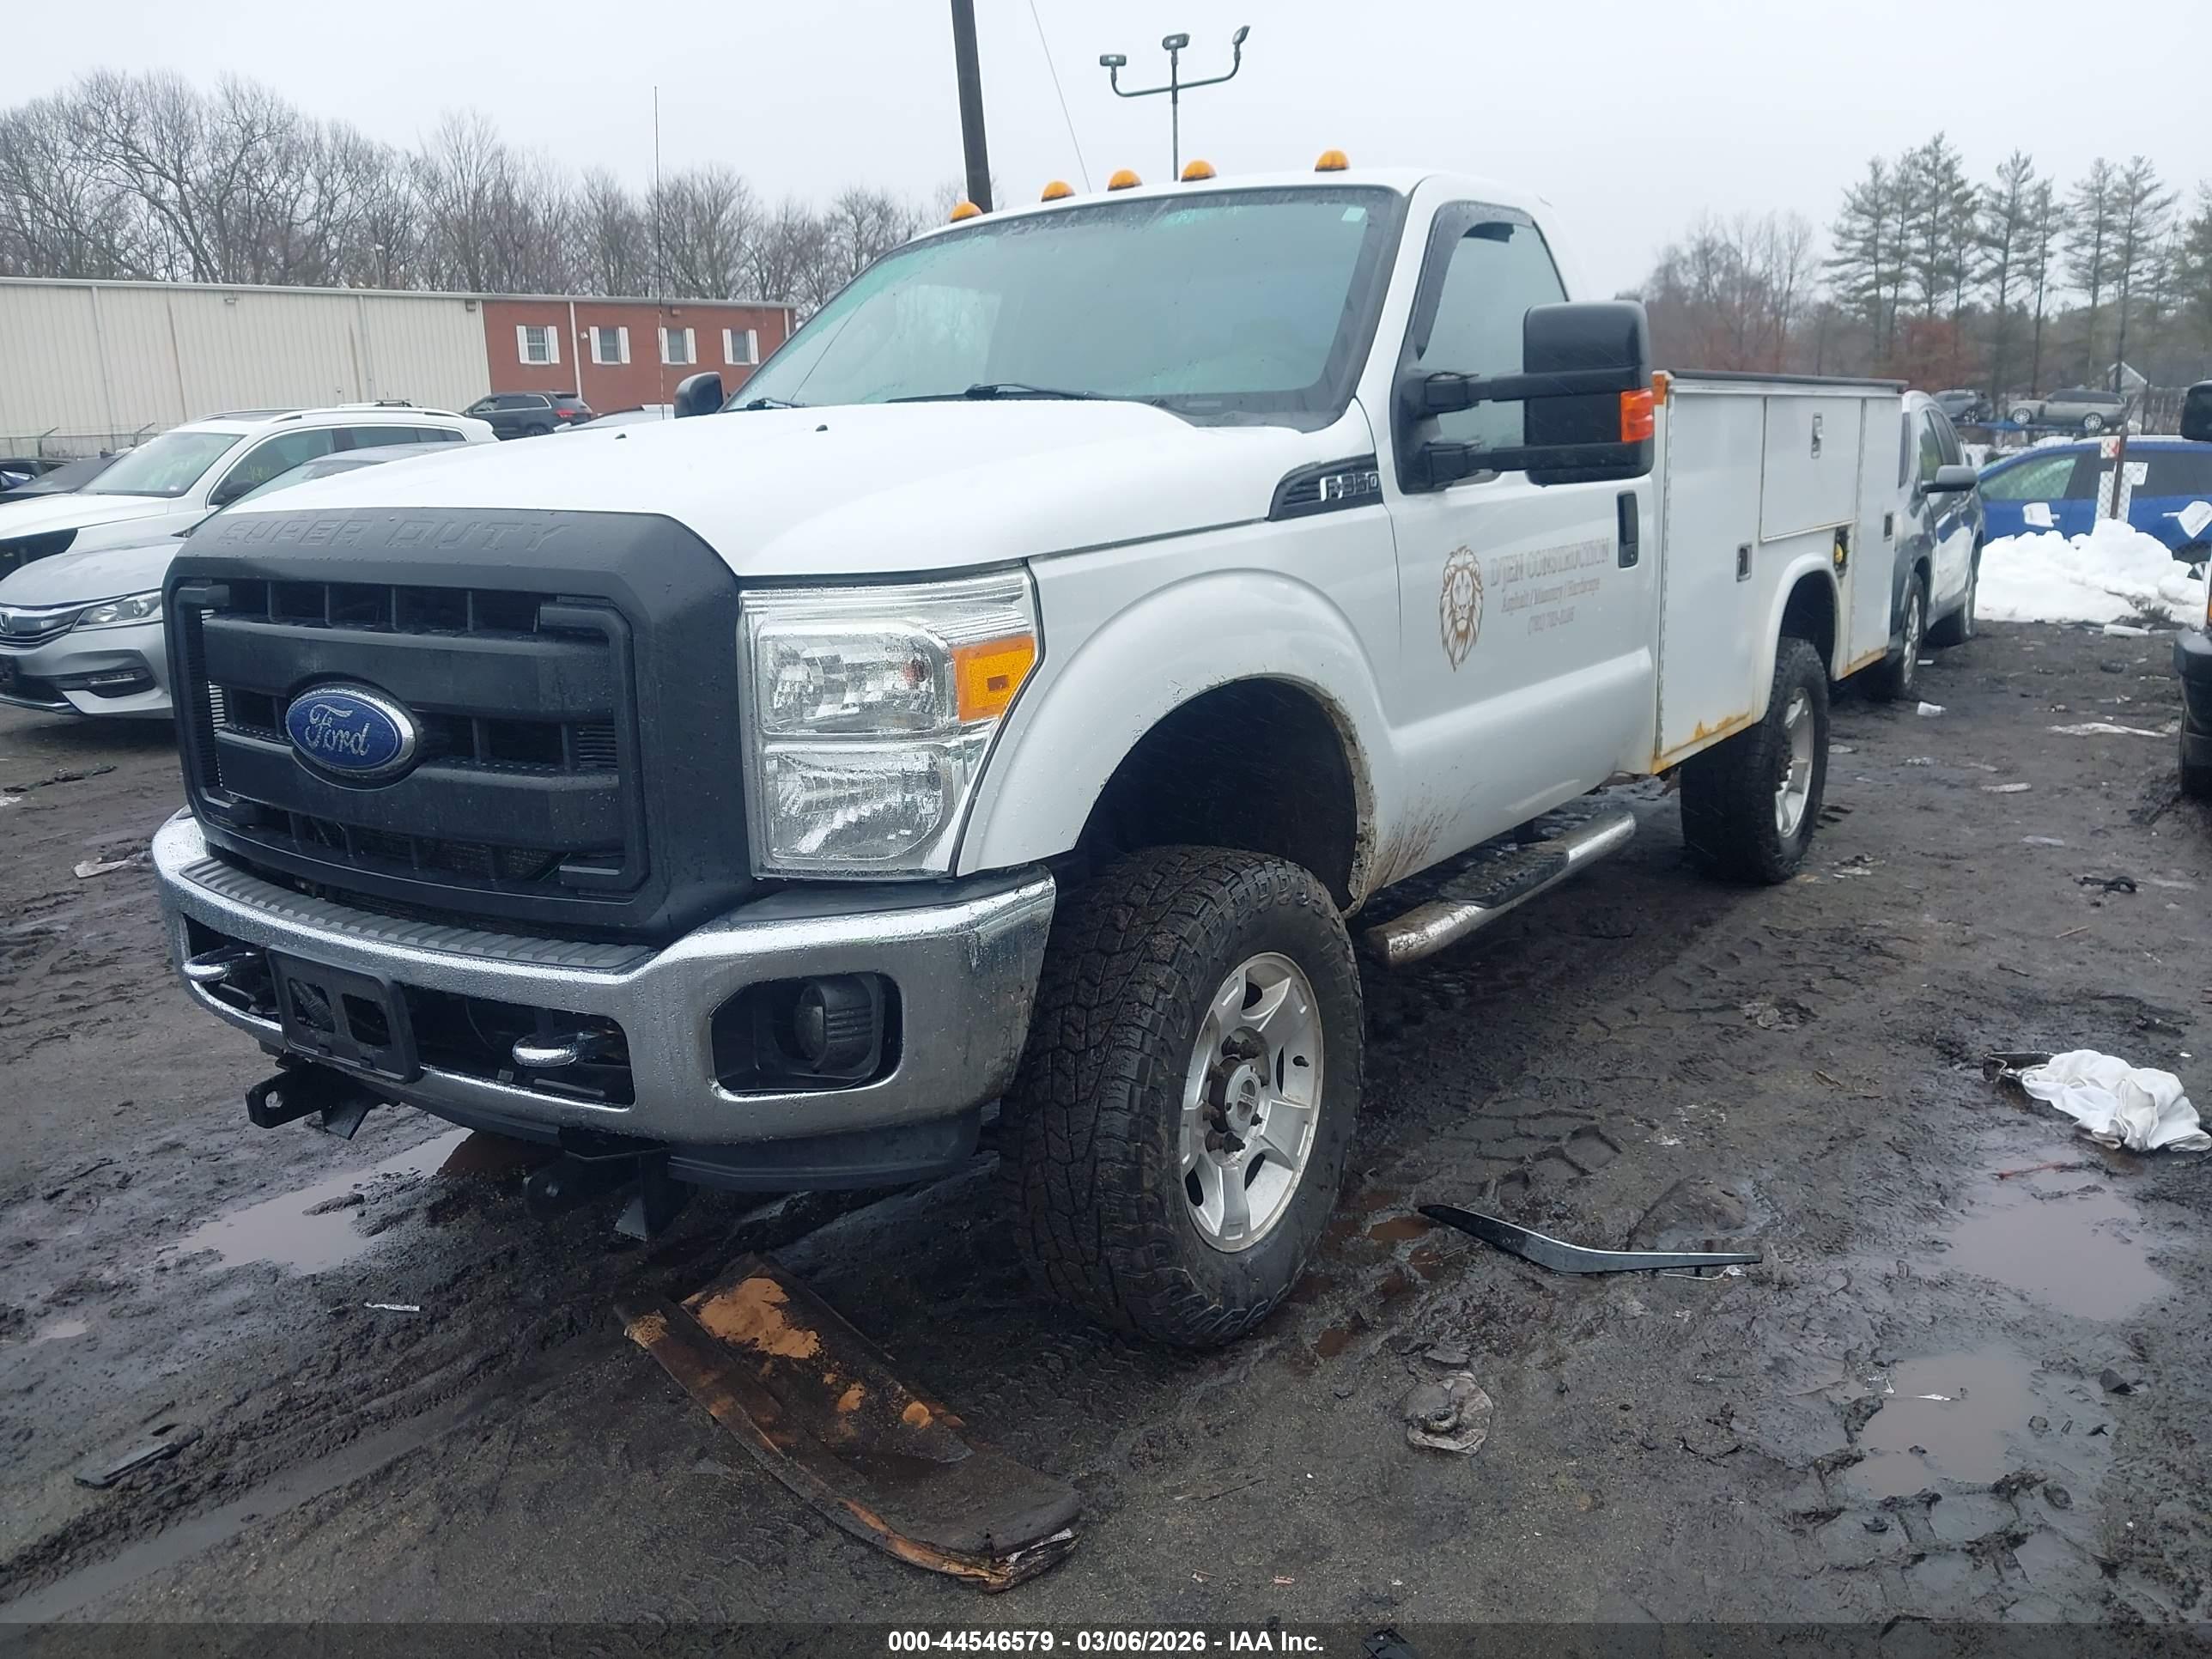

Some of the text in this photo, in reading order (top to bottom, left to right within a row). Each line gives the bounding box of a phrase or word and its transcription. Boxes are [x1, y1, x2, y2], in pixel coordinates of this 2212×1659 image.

[217, 518, 571, 552] SUPER DUTY
[305, 703, 370, 757] Ford
